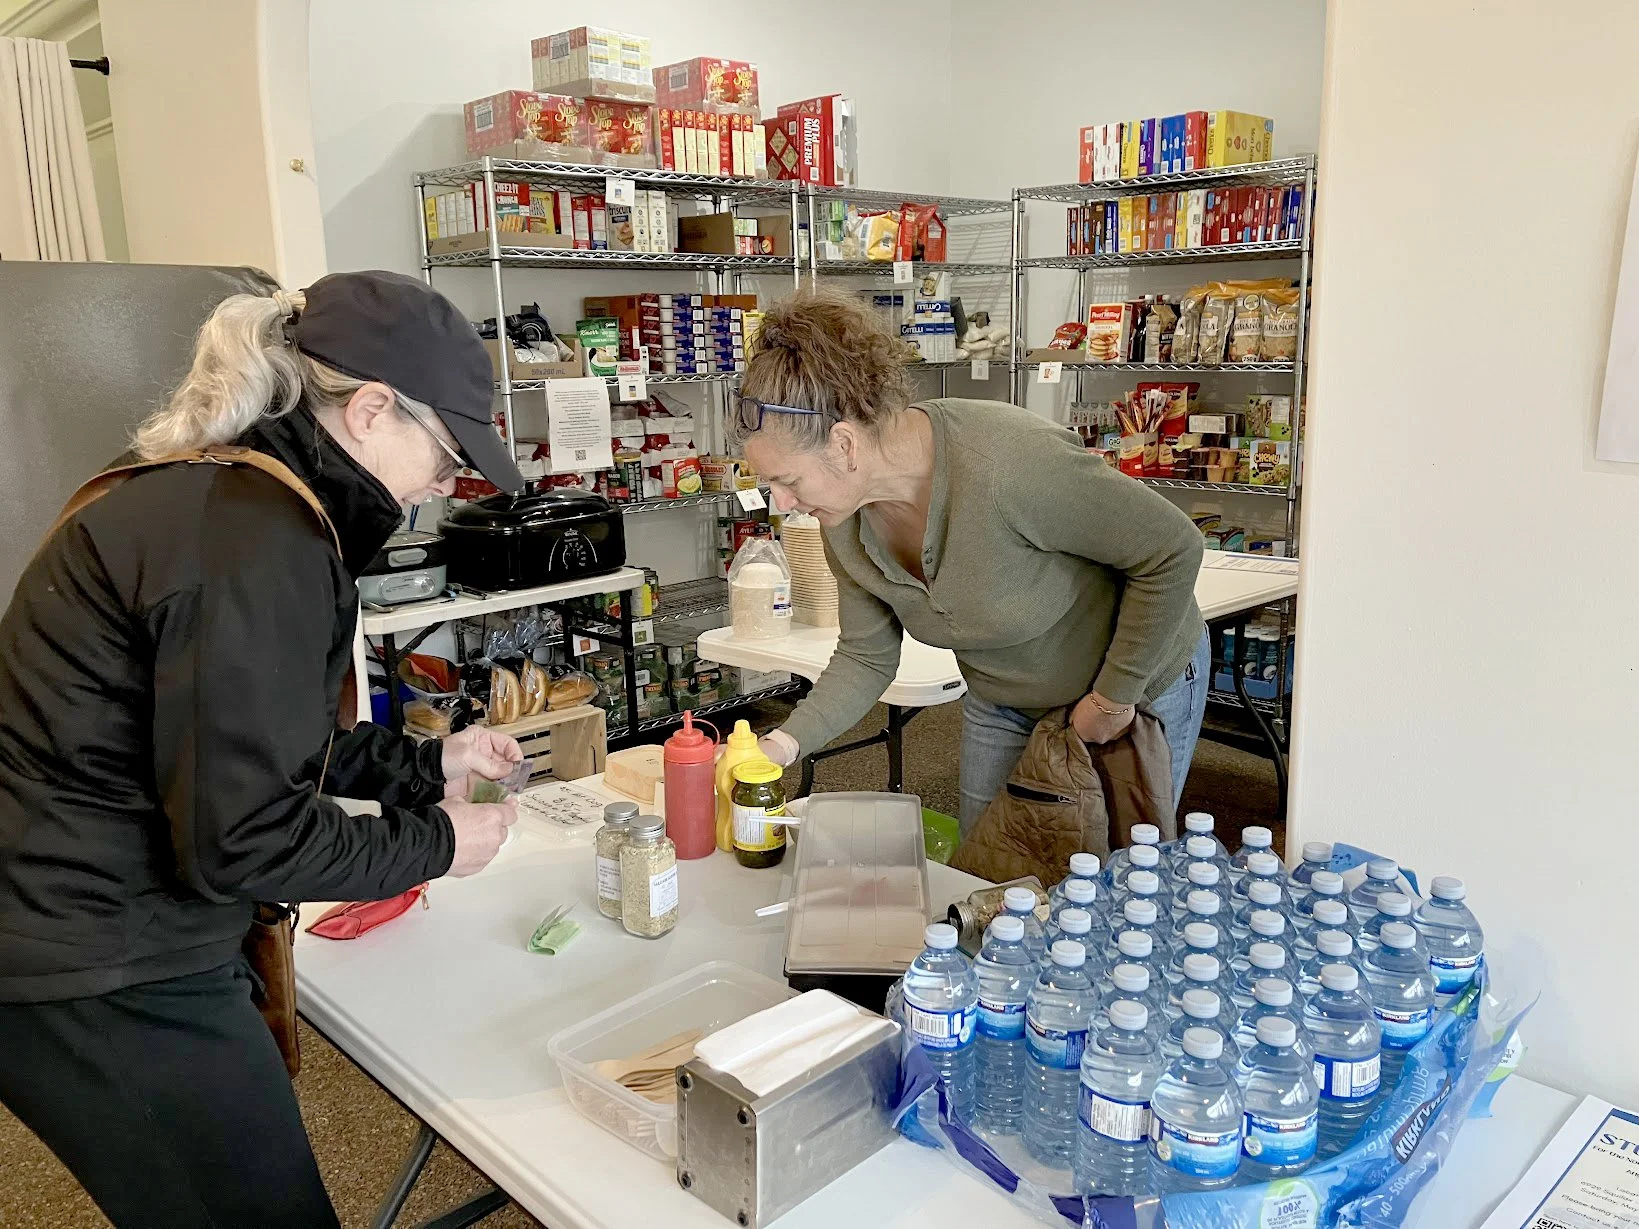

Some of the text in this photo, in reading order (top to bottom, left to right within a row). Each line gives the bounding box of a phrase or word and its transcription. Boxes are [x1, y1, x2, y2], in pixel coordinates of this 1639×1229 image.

[517, 99, 544, 118] Stove
[555, 103, 580, 121] Stove
[589, 105, 614, 125] Stove
[623, 109, 648, 129] Stove
[812, 118, 820, 143] PLUS
[804, 117, 813, 165] PREMIUM
[1187, 1134, 1219, 1143] KIRKLAND
[1609, 1151, 1625, 1160] the
[1561, 1194, 1589, 1207] Please
